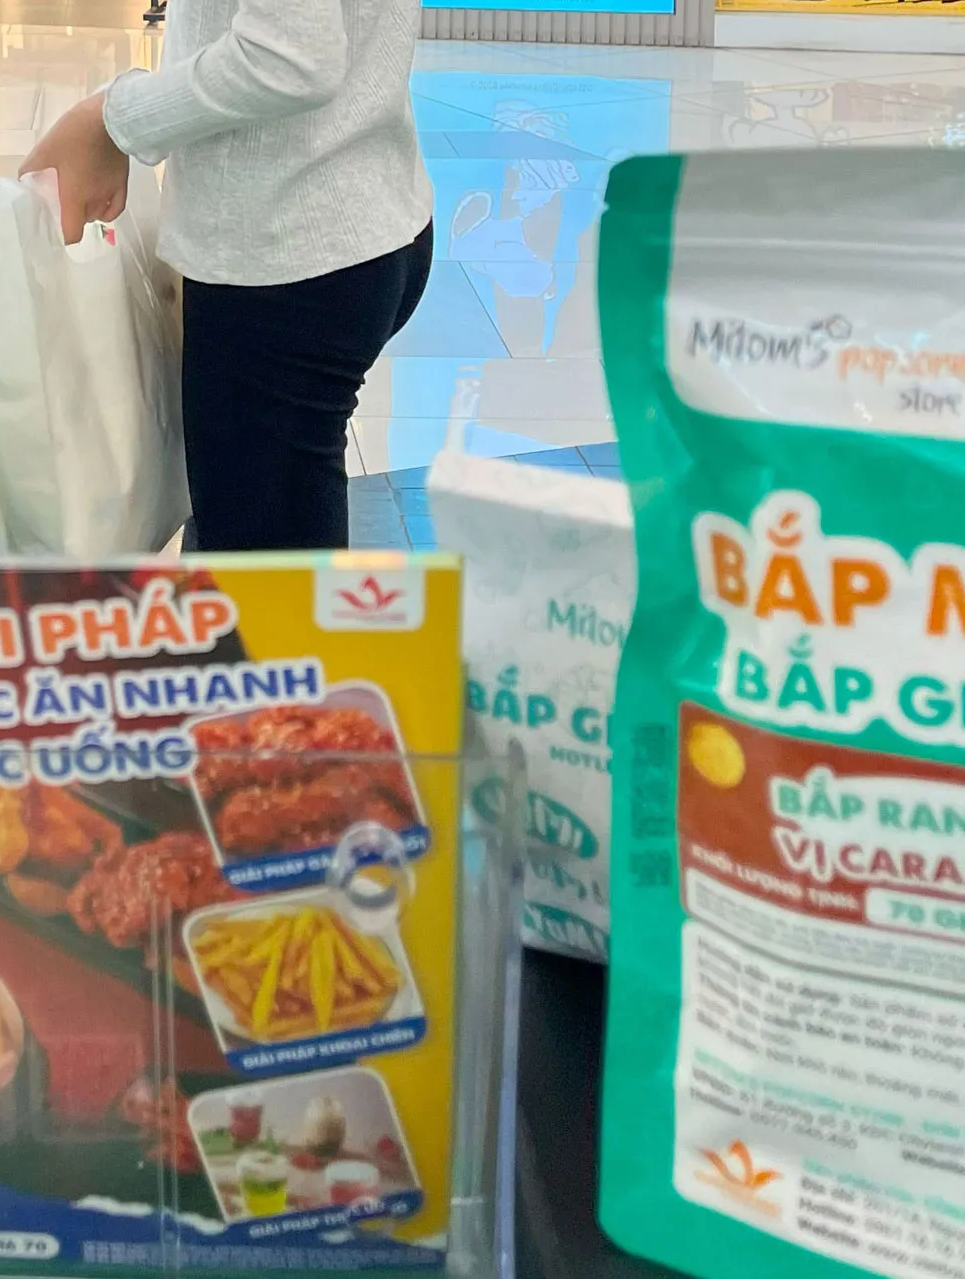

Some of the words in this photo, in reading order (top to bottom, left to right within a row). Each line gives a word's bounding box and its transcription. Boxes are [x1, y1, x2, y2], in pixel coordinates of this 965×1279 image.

[711, 510, 890, 627] BẮP
[32, 582, 232, 653] PHÁP
[31, 673, 106, 720] ĂN
[122, 665, 320, 713] NHANH
[736, 635, 874, 717] BẮP
[38, 726, 194, 782] UỐNG
[779, 773, 864, 821] BẮP
